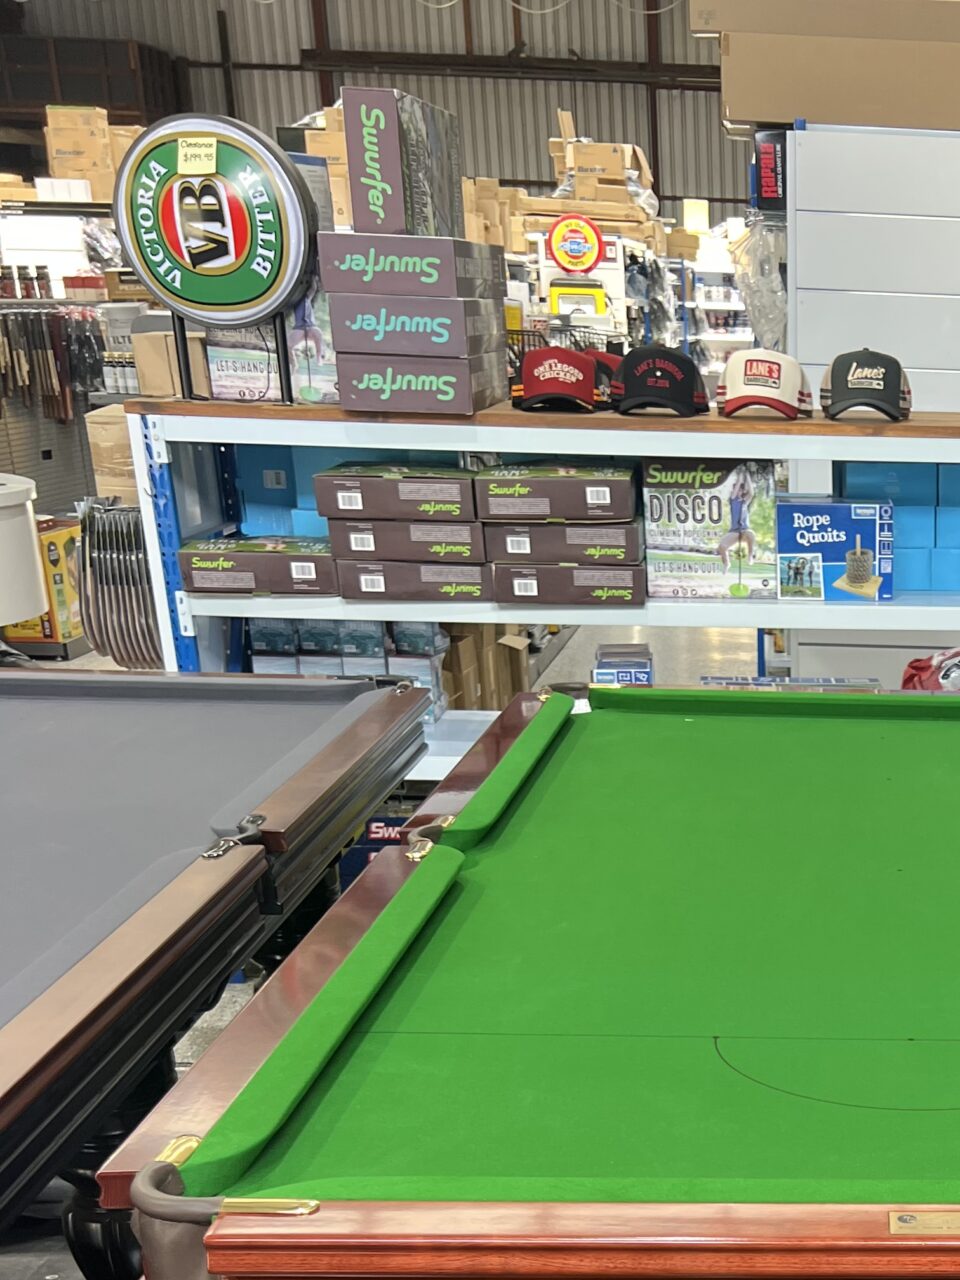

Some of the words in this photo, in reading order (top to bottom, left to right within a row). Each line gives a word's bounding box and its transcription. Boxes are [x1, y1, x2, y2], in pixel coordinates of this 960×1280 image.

[360, 104, 392, 220] Swurfer
[137, 159, 182, 290] VICTORIA
[178, 177, 231, 270] VB
[238, 165, 277, 280] BITTER
[339, 248, 441, 284] Swurfer
[351, 308, 452, 343] Swurfer
[240, 360, 265, 374] HANG
[746, 360, 779, 379] LANE'S
[847, 361, 886, 380] Lane's
[358, 367, 457, 401] Swurfer
[646, 464, 722, 489] Swurfer
[488, 483, 530, 497] Swurfer
[418, 502, 461, 515] Swurfer
[649, 494, 723, 524] DISCO
[792, 512, 831, 531] Rope
[795, 527, 847, 547] Quoits
[429, 543, 471, 556] Swurfer
[585, 546, 626, 559] Swurfer
[191, 557, 235, 570] Swurfer
[675, 562, 699, 573] HANG
[440, 583, 482, 596] Swurfer
[592, 588, 633, 600] Swurfer
[367, 822, 401, 839] Sw
